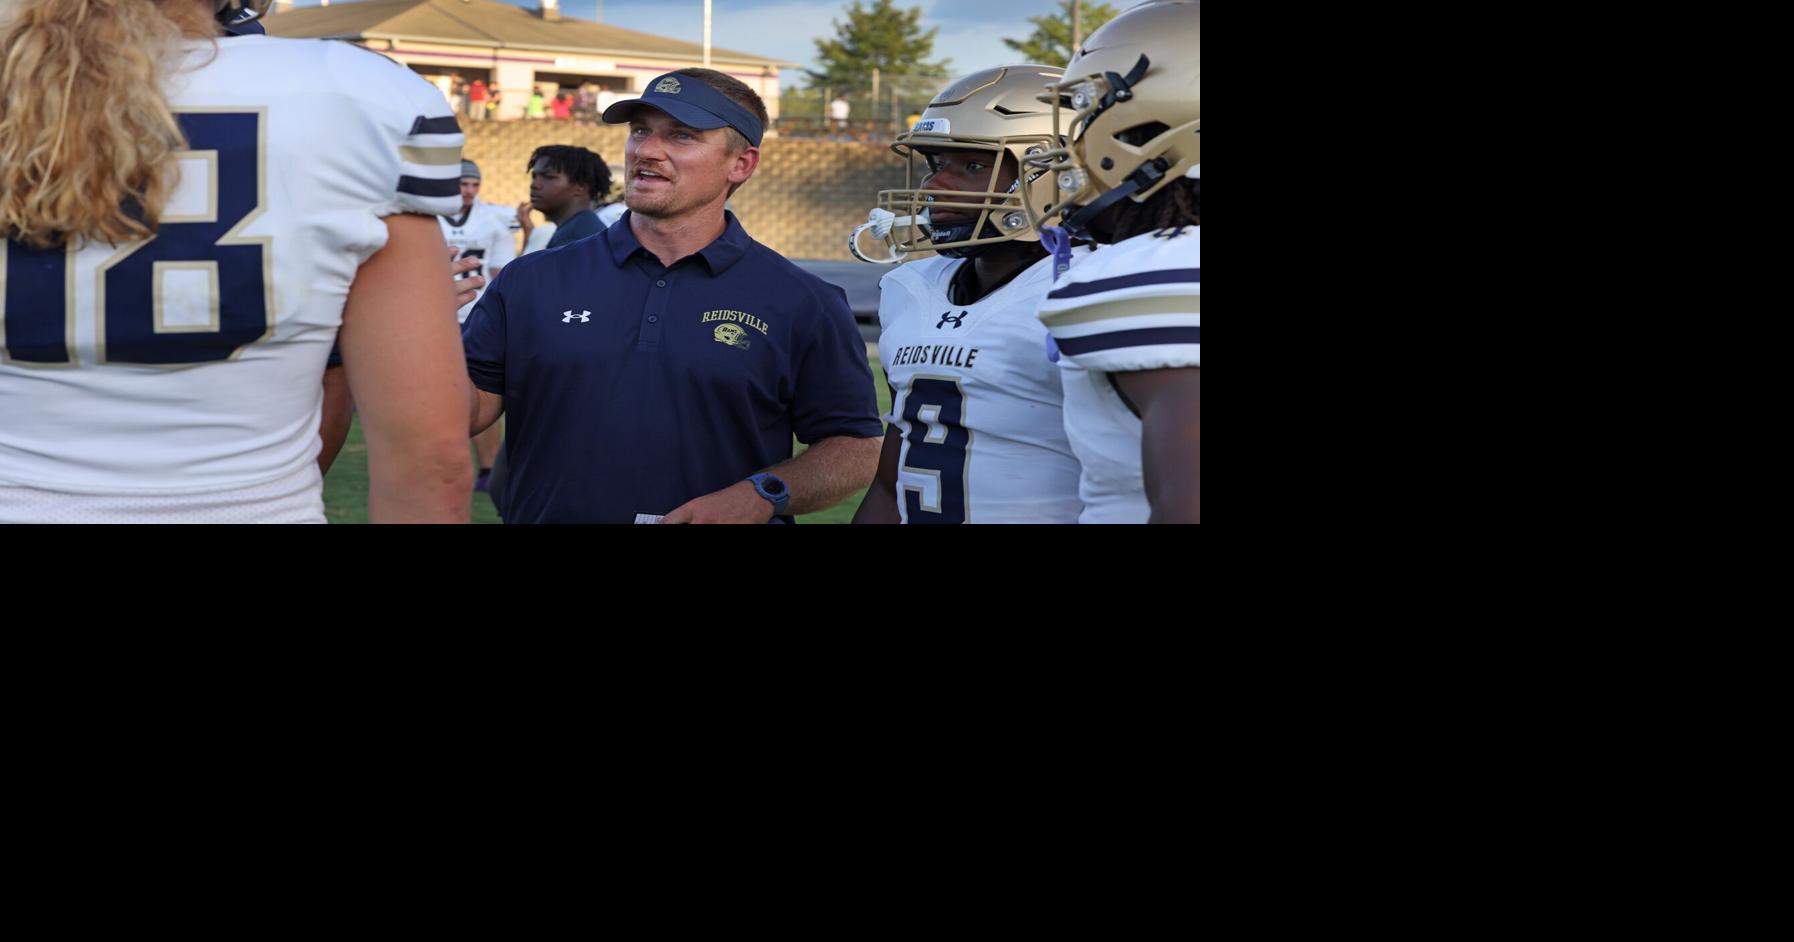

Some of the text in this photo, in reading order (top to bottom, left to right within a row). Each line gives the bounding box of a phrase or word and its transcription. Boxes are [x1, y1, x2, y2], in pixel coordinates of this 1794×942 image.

[701, 309, 769, 335] REIDSVILLE
[893, 345, 979, 368] REIDSVILLE
[902, 374, 974, 524] 9
